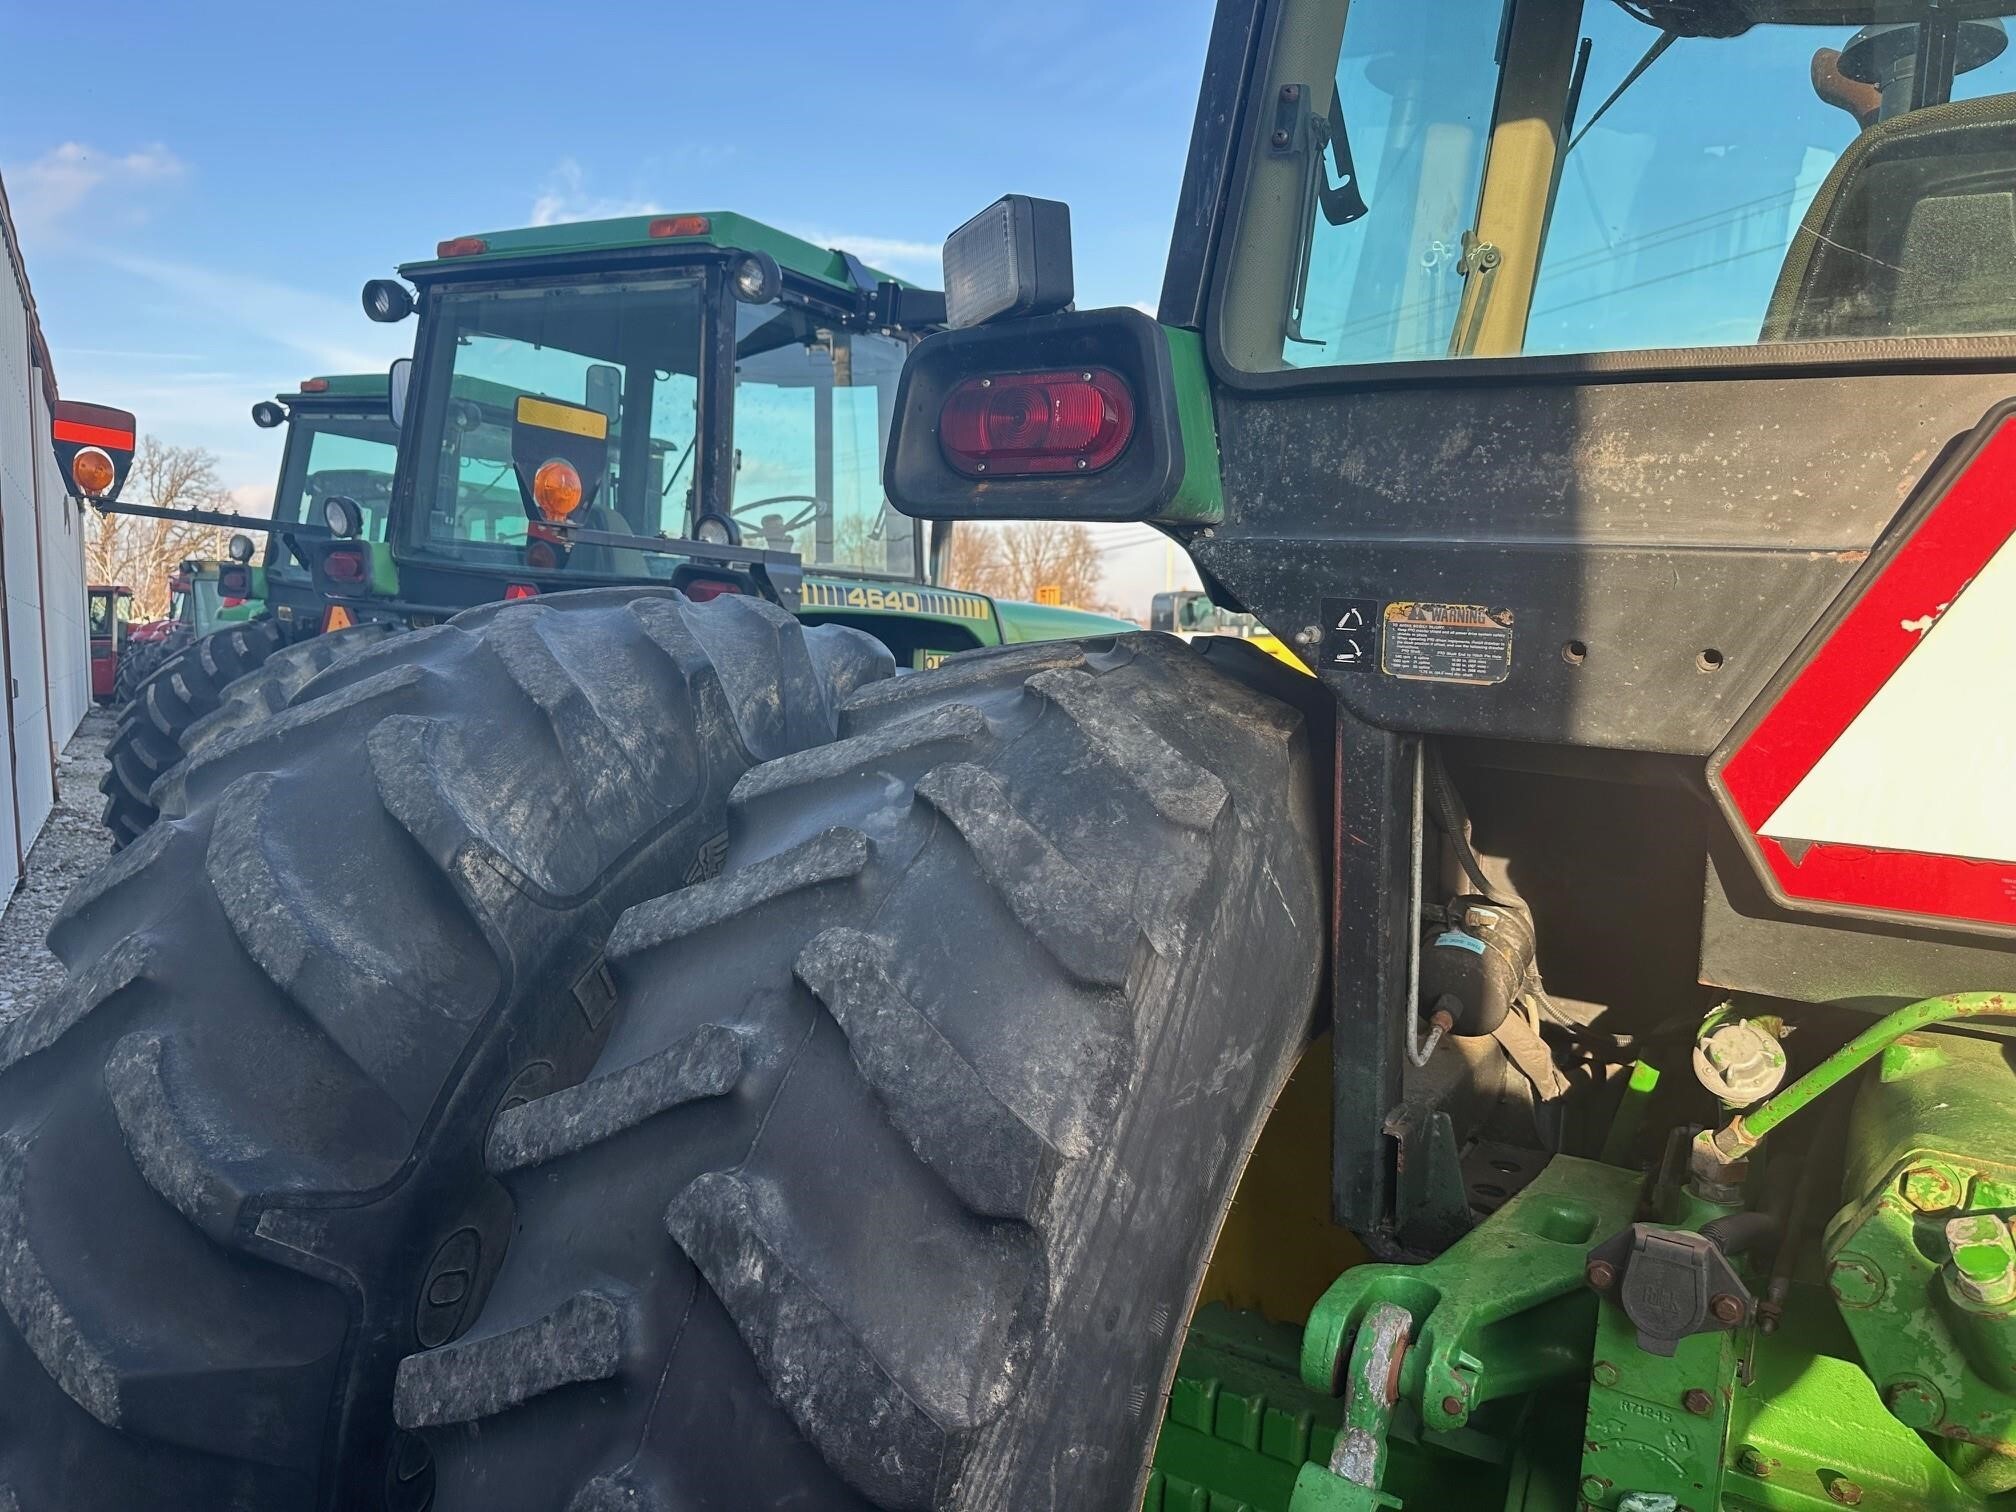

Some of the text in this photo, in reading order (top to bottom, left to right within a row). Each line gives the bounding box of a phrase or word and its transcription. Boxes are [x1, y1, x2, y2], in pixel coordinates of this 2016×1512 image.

[848, 587, 920, 613] 4640
[1431, 606, 1486, 624] WARNING
[1619, 1400, 1673, 1424] R71245
